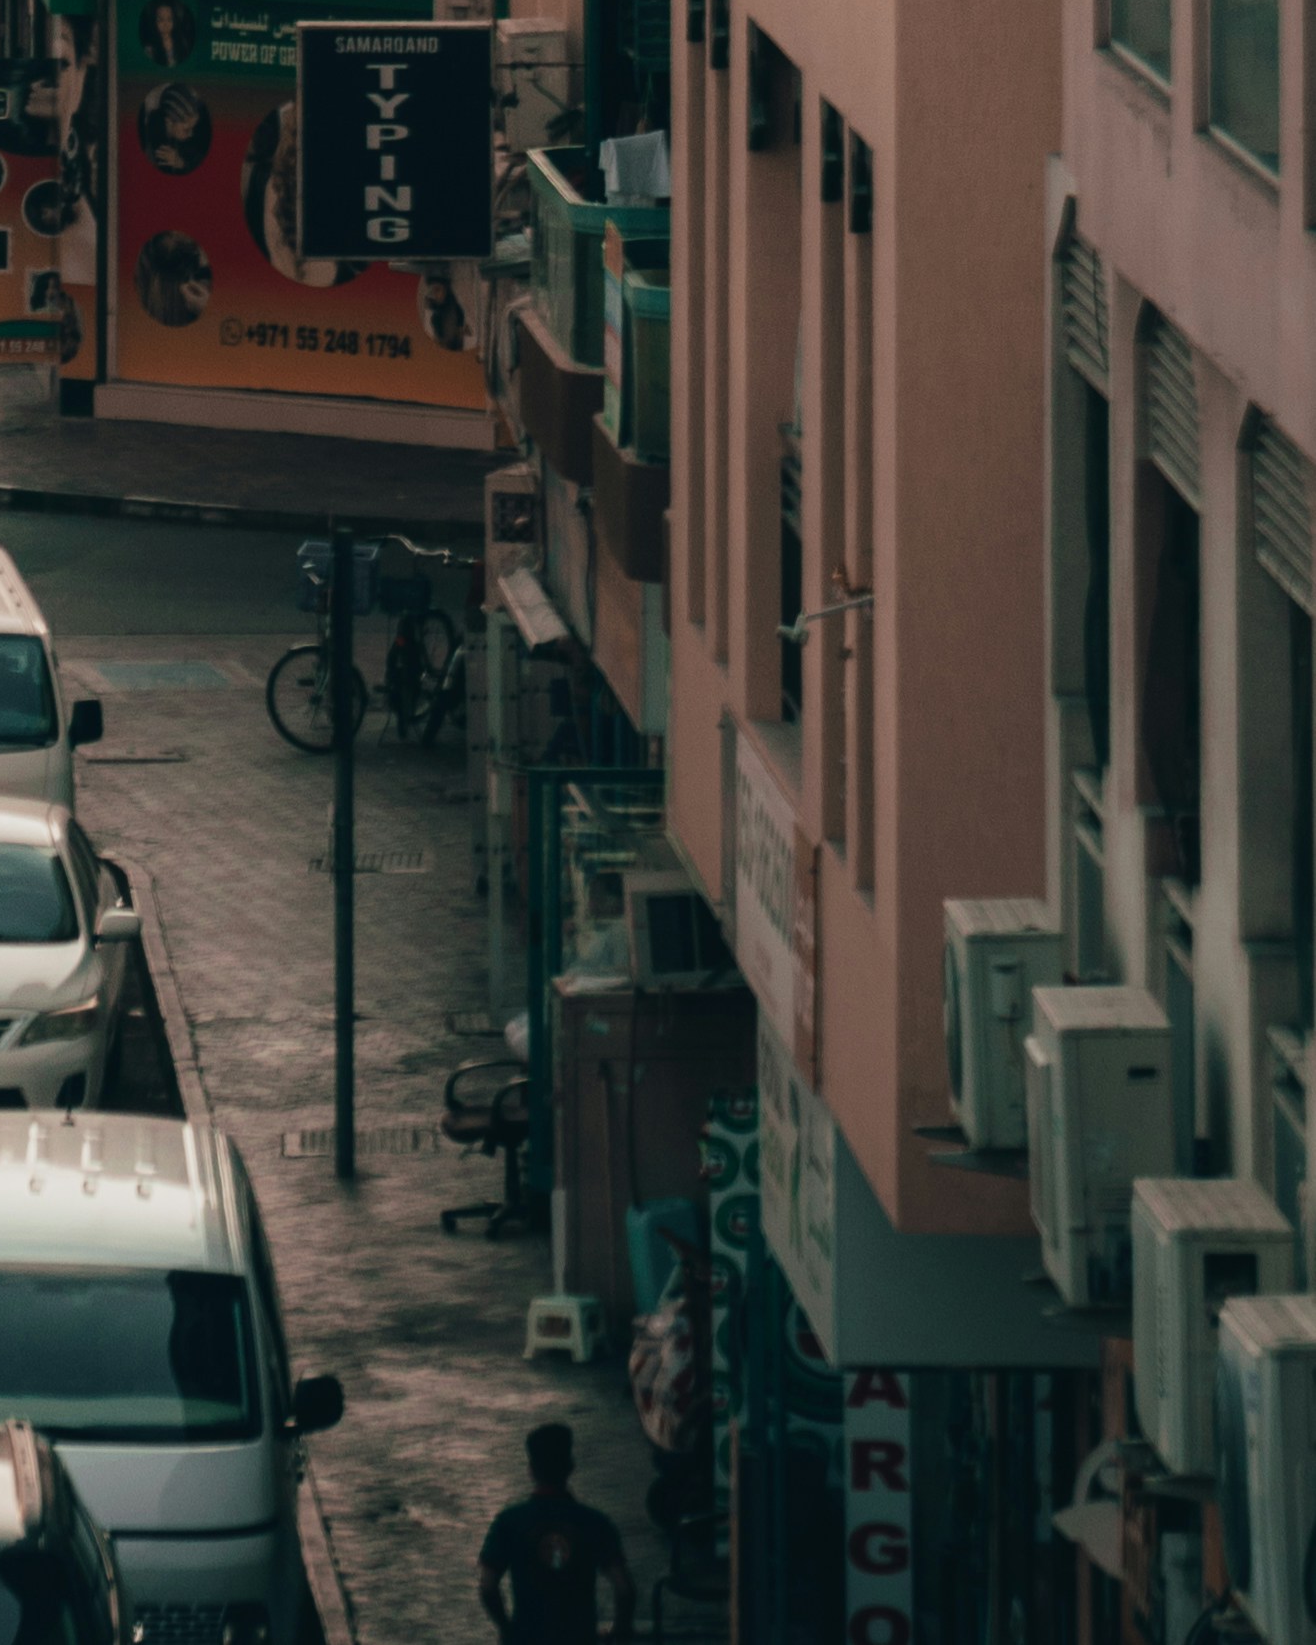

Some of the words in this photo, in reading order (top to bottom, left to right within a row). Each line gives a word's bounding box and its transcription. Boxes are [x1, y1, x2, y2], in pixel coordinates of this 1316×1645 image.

[211, 41, 258, 63] POWER
[260, 44, 278, 65] OF
[279, 46, 297, 66] GR
[364, 63, 412, 243] TYPING
[247, 321, 289, 349] +971
[296, 326, 319, 351] 55
[323, 328, 360, 355] 248
[365, 332, 412, 359] 1794
